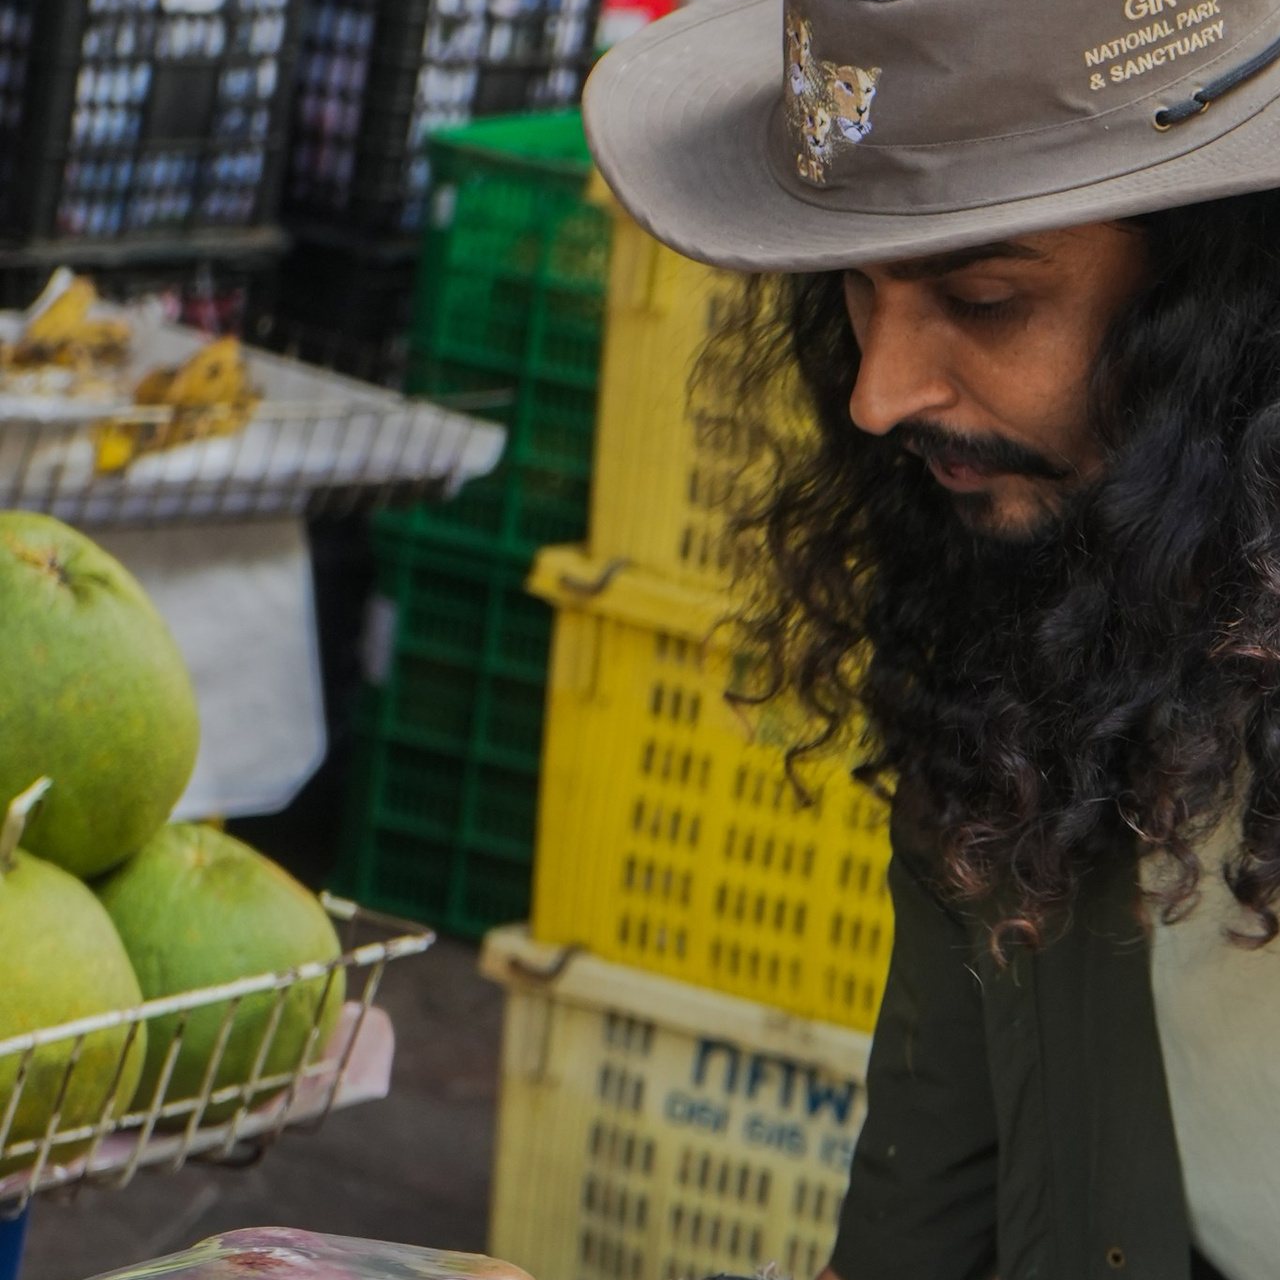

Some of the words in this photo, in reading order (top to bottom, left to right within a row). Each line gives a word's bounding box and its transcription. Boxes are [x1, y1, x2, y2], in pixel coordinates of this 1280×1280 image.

[1085, 21, 1174, 67] NATIONAL
[1089, 73, 1106, 90] &
[1110, 20, 1224, 82] SANCTUARY
